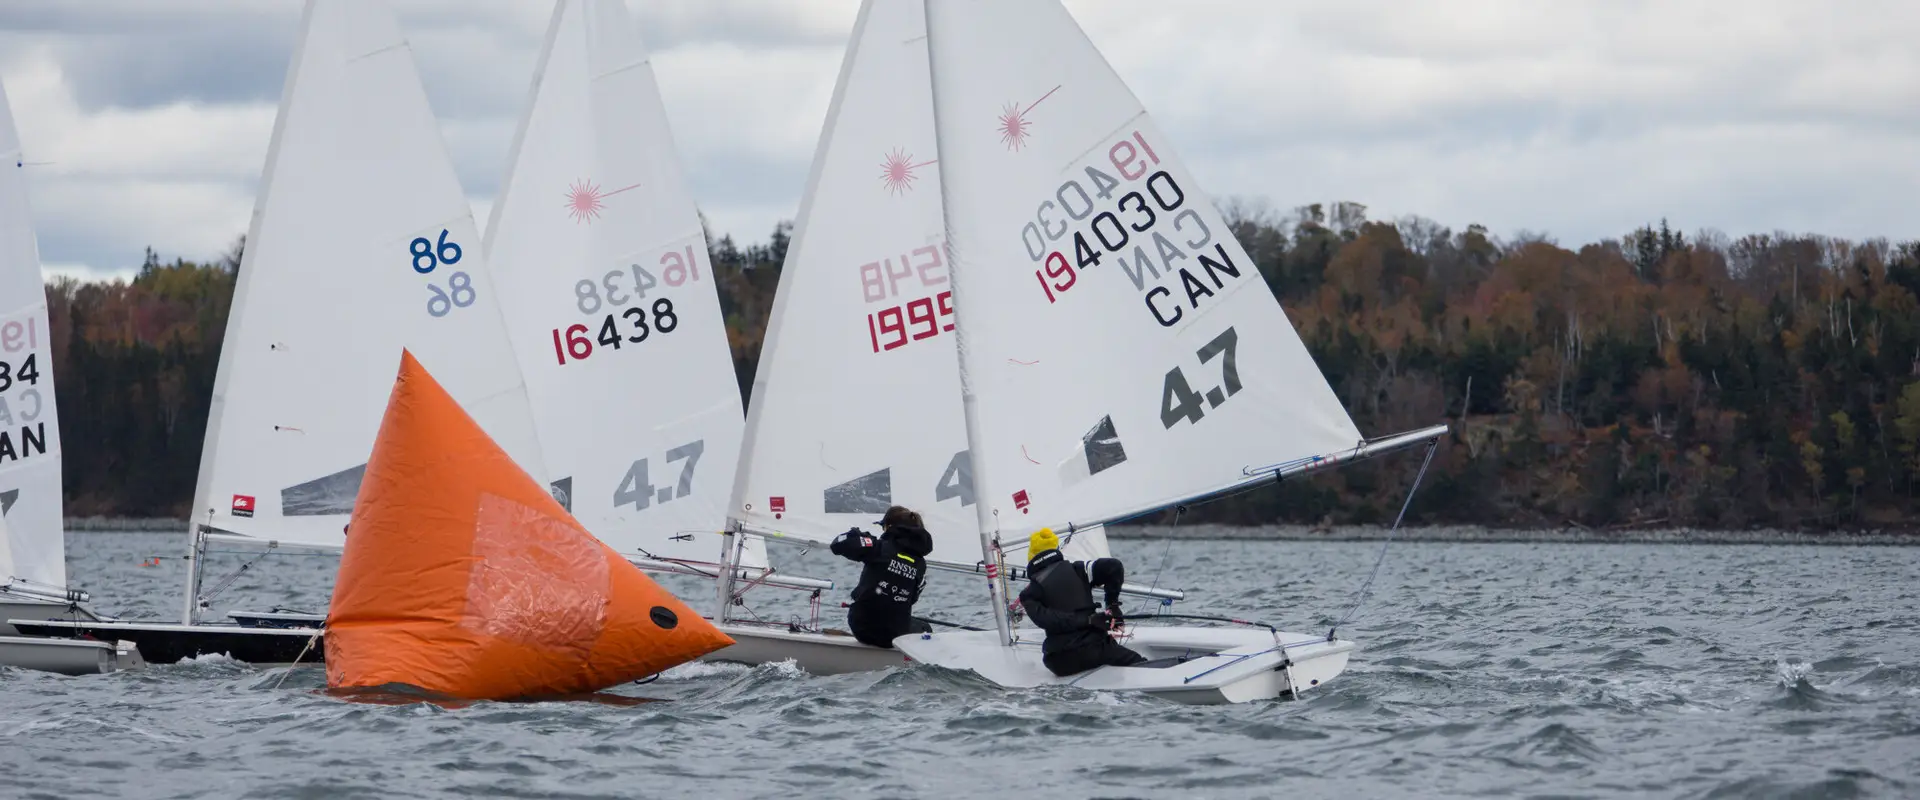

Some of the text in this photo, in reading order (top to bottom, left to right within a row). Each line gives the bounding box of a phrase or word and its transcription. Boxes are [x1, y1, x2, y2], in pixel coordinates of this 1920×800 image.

[410, 229, 462, 273] 86
[1035, 170, 1185, 303] 194030
[1144, 243, 1241, 327] CAN
[552, 298, 678, 365] 16438
[1160, 326, 1243, 430] 4.7
[613, 439, 704, 511] 4.7
[890, 559, 917, 576] RNSYS
